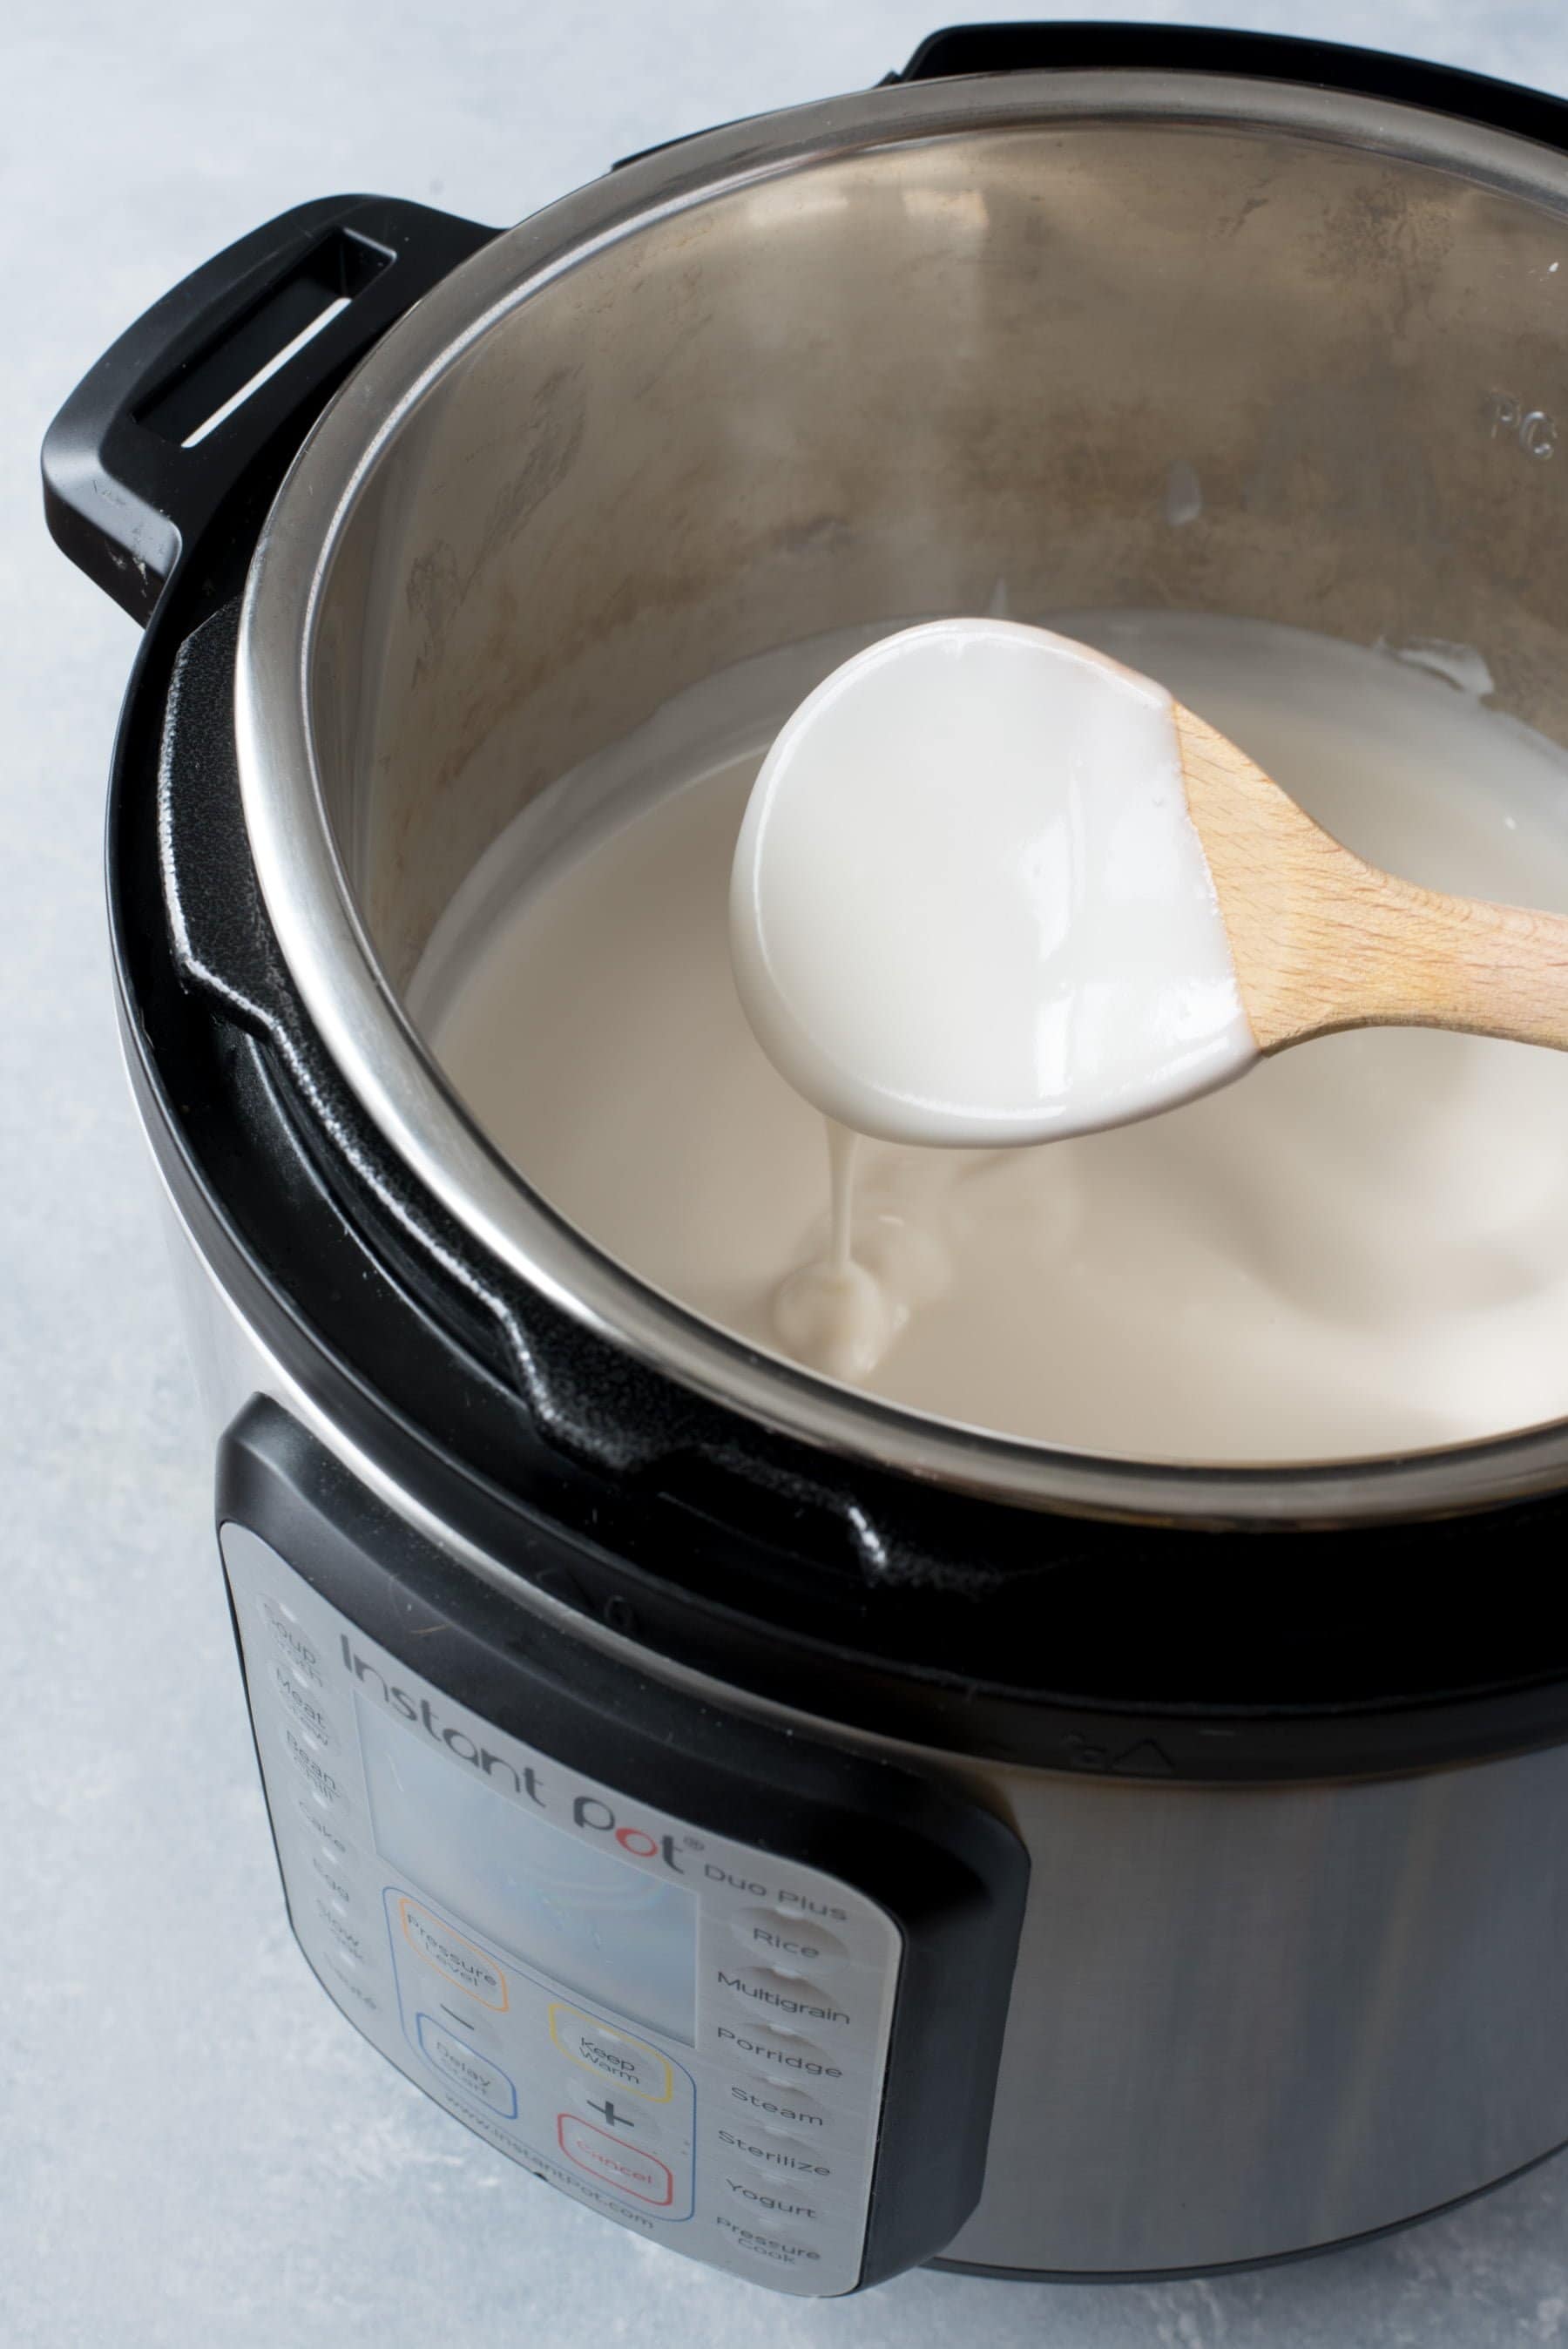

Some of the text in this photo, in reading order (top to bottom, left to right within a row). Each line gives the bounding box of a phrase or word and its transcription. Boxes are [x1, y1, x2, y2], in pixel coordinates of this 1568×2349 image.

[276, 1665, 326, 1730] Meat
[341, 1633, 546, 1808] Instant
[286, 1730, 336, 1791] Bean
[704, 1863, 848, 1921] Duo Plus
[407, 1913, 497, 1987] Pressure
[754, 1927, 820, 1959] Rice
[717, 1970, 850, 2025] Multigrain
[579, 2047, 641, 2085] Warm
[580, 2037, 635, 2072] Keep
[717, 2027, 843, 2079] Porridge
[731, 2087, 823, 2126] Steam
[576, 2139, 652, 2184] Cancel
[718, 2129, 831, 2176] Sterilize
[726, 2178, 817, 2218] Yogurt
[716, 2216, 821, 2261] Pressure
[738, 2237, 796, 2264] Cook
